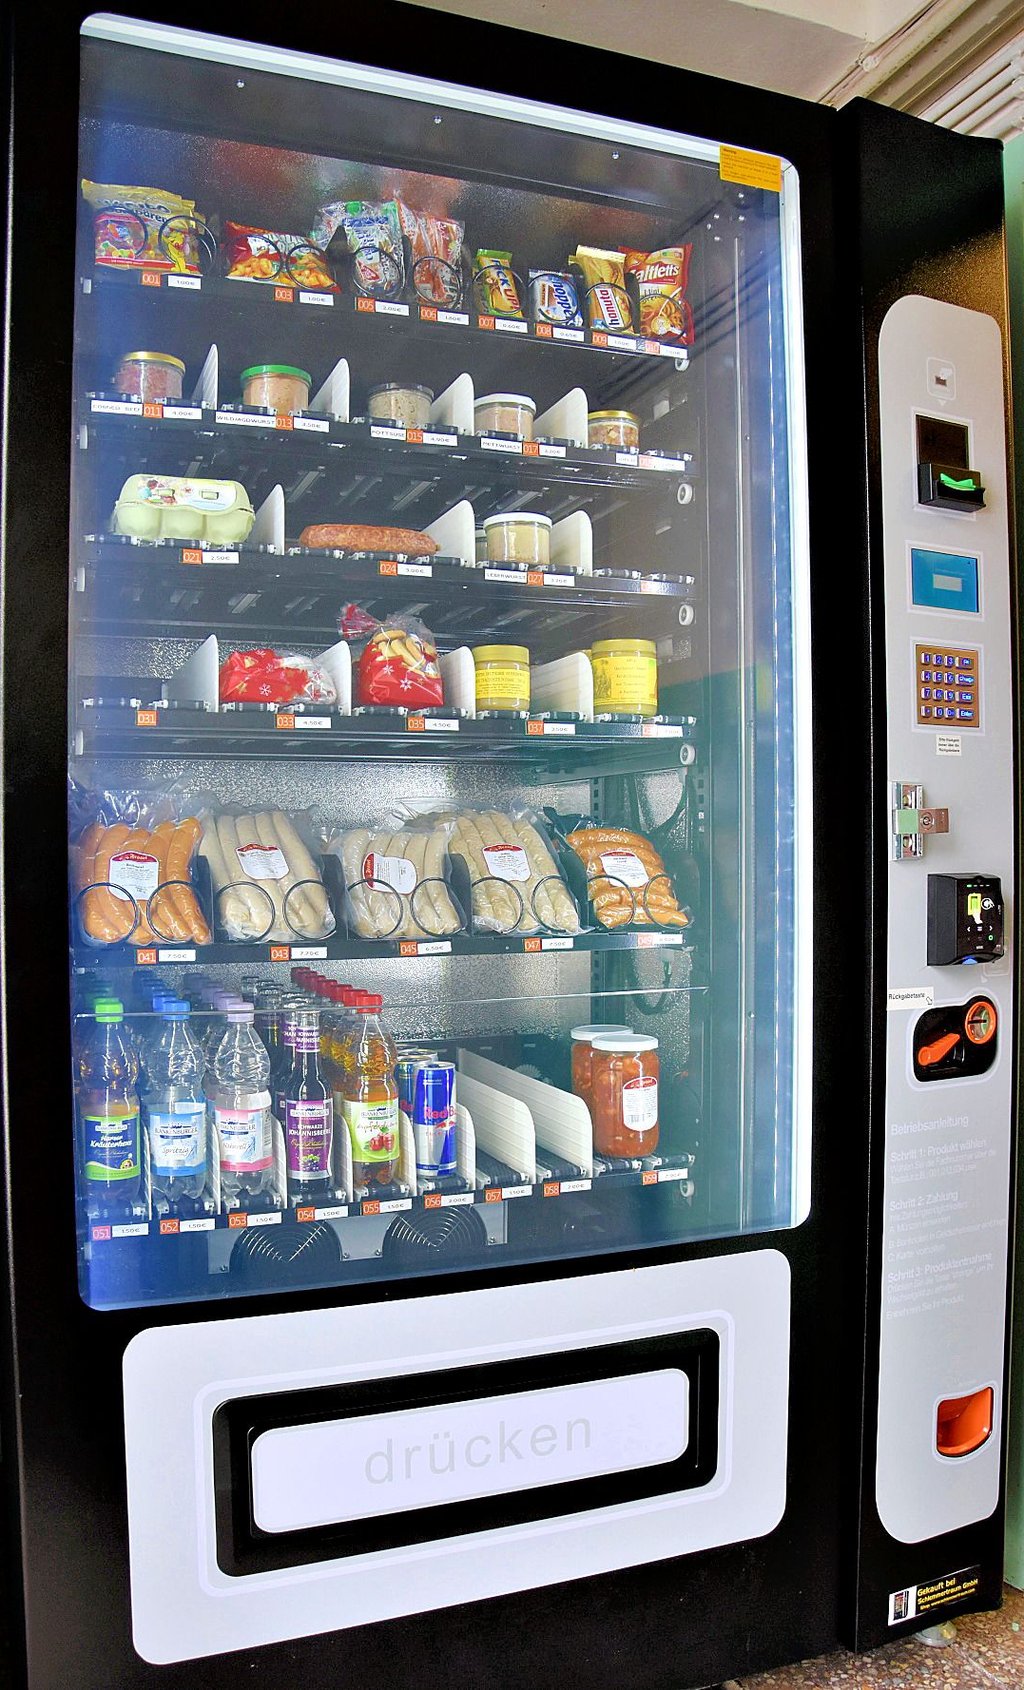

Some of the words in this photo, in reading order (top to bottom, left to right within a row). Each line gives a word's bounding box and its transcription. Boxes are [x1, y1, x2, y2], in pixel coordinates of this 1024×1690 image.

[144, 274, 160, 284] 001
[276, 290, 293, 300] 003
[504, 288, 521, 310] UP!
[358, 300, 374, 310] 005
[600, 289, 619, 326] hanuta
[421, 310, 436, 319] 006
[479, 318, 494, 328] 007
[537, 326, 551, 335] 008
[593, 335, 607, 345] 009
[145, 406, 162, 416] 011
[276, 416, 292, 428] 013
[407, 432, 422, 442] 015
[524, 443, 538, 454] 017
[183, 552, 201, 562] 021
[381, 564, 396, 574] 024
[528, 574, 543, 584] 027
[139, 713, 156, 724] 031
[277, 717, 294, 727] 033
[408, 719, 424, 729] 035
[528, 723, 543, 733] 037
[401, 944, 416, 954] 045
[525, 940, 540, 950] 047
[139, 952, 156, 962] 041
[271, 949, 288, 959] 043
[890, 1115, 969, 1136] Betriebsanleitung
[890, 1148, 917, 1162] Schritt
[927, 1143, 958, 1157] Produkt
[544, 1185, 559, 1195] 058
[486, 1191, 501, 1201] 057
[425, 1197, 440, 1206] 056
[889, 1198, 916, 1211] Schritt
[363, 1204, 379, 1213] 055
[298, 1210, 314, 1220] 054
[229, 1216, 246, 1226] 053
[161, 1222, 178, 1232] 052
[93, 1229, 111, 1239] 051
[364, 1416, 592, 1485] drücken
[917, 1581, 944, 1597] Gekauft
[945, 1577, 956, 1587] bei
[962, 1578, 979, 1589] GmbH
